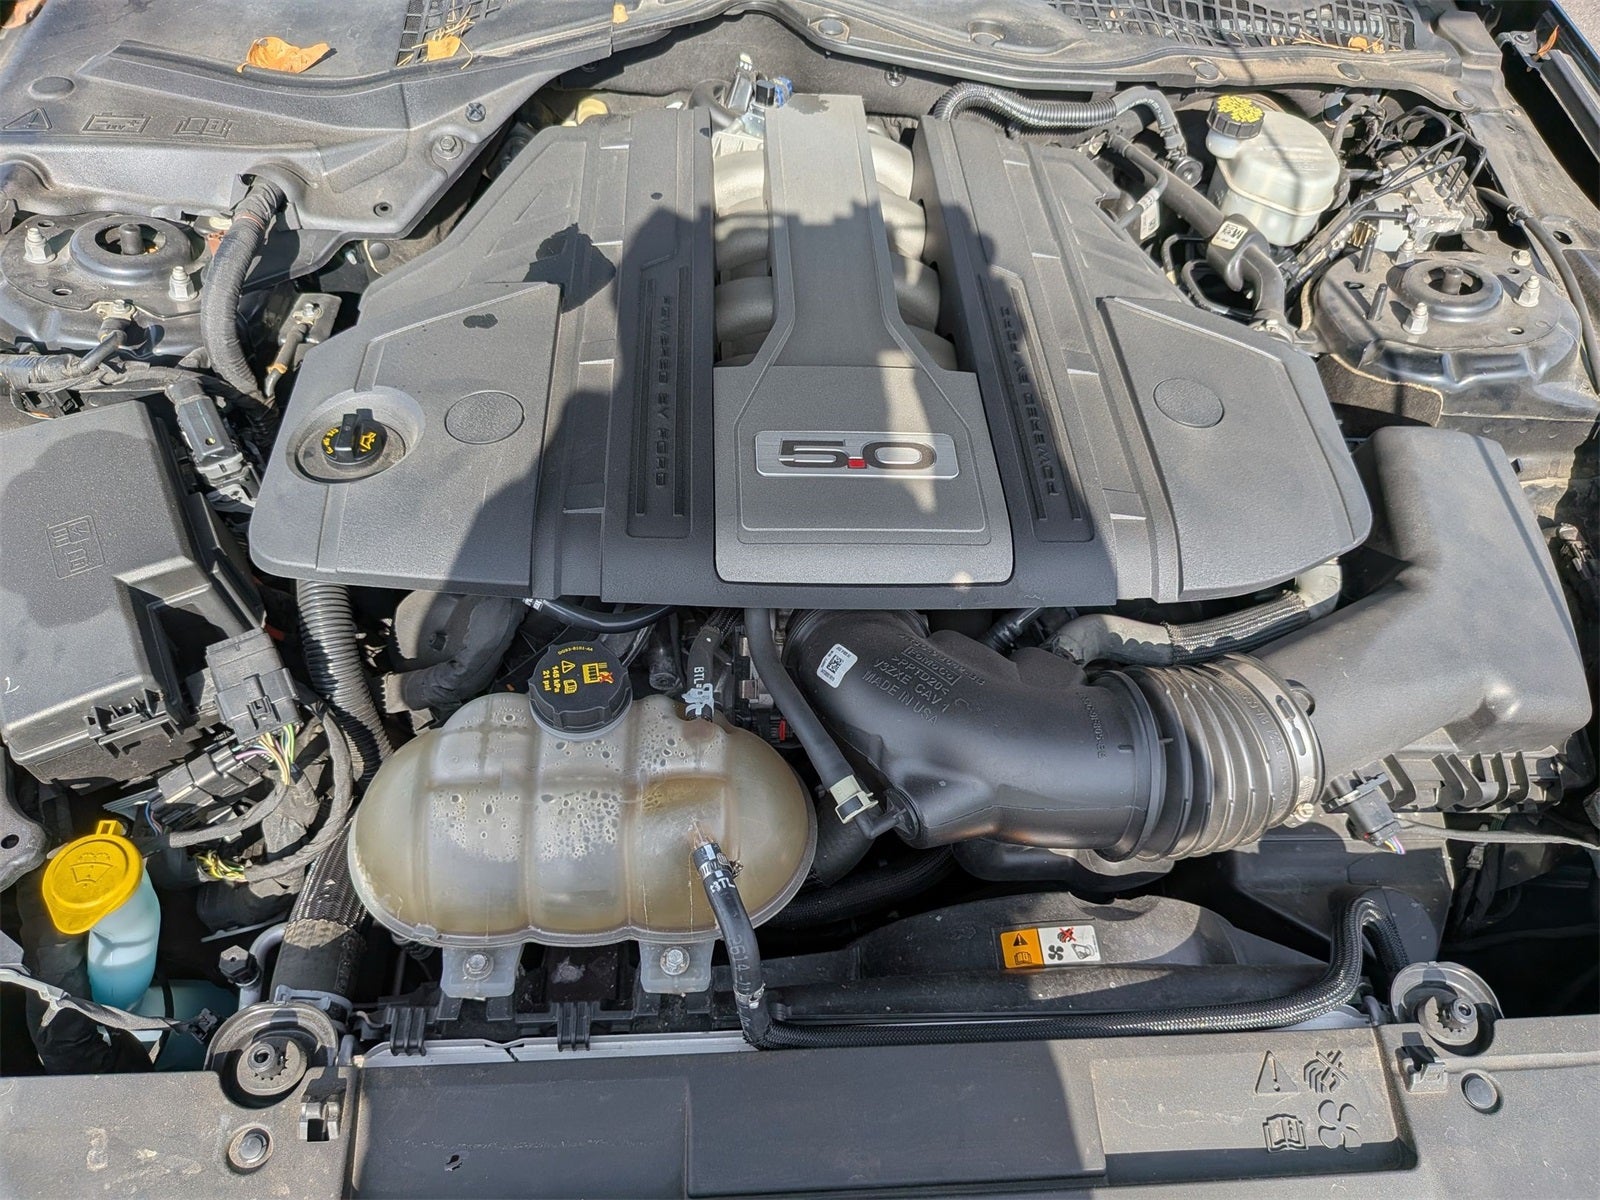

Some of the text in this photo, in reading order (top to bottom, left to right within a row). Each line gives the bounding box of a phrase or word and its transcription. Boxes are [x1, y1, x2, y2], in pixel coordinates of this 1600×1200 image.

[779, 439, 937, 470] 5.0
[551, 664, 561, 678] 145
[693, 666, 705, 685] BTL
[907, 648, 956, 681] FoMoCo
[542, 669, 552, 691] 21 psi
[862, 670, 900, 696] MADE
[899, 690, 914, 707] IN
[912, 702, 939, 727] USA
[914, 682, 943, 705] CAV
